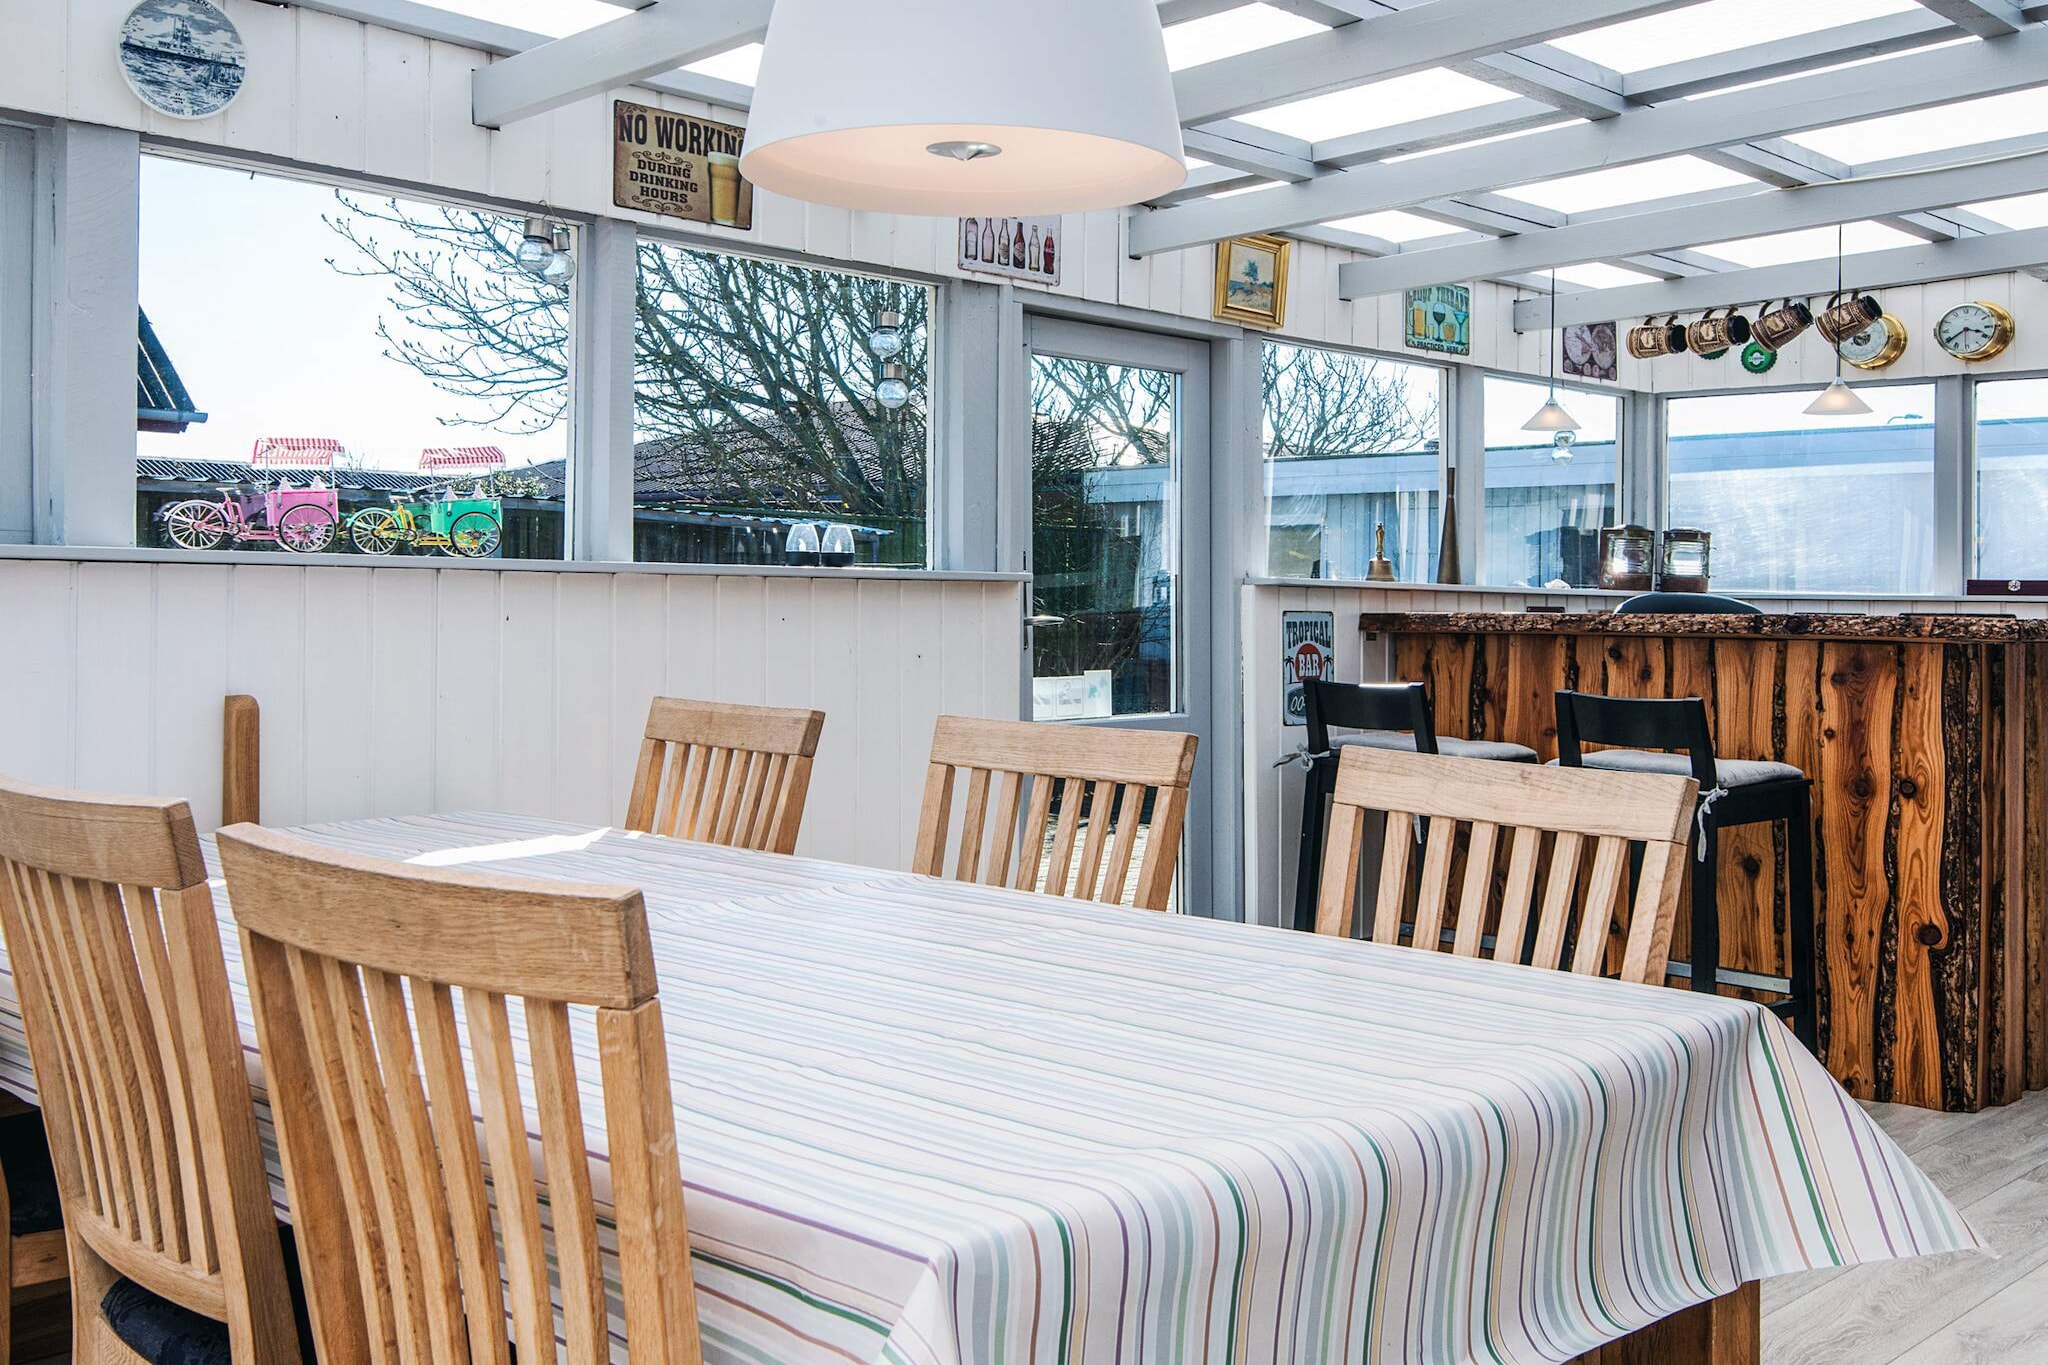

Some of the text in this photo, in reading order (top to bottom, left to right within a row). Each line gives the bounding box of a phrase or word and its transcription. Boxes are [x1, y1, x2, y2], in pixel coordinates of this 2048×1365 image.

[619, 113, 648, 145] NO
[637, 159, 691, 179] DURING
[629, 170, 699, 193] DRINKING
[640, 185, 688, 203] HOURS
[1286, 621, 1331, 649] TROPICAL
[1298, 653, 1320, 677] BAR
